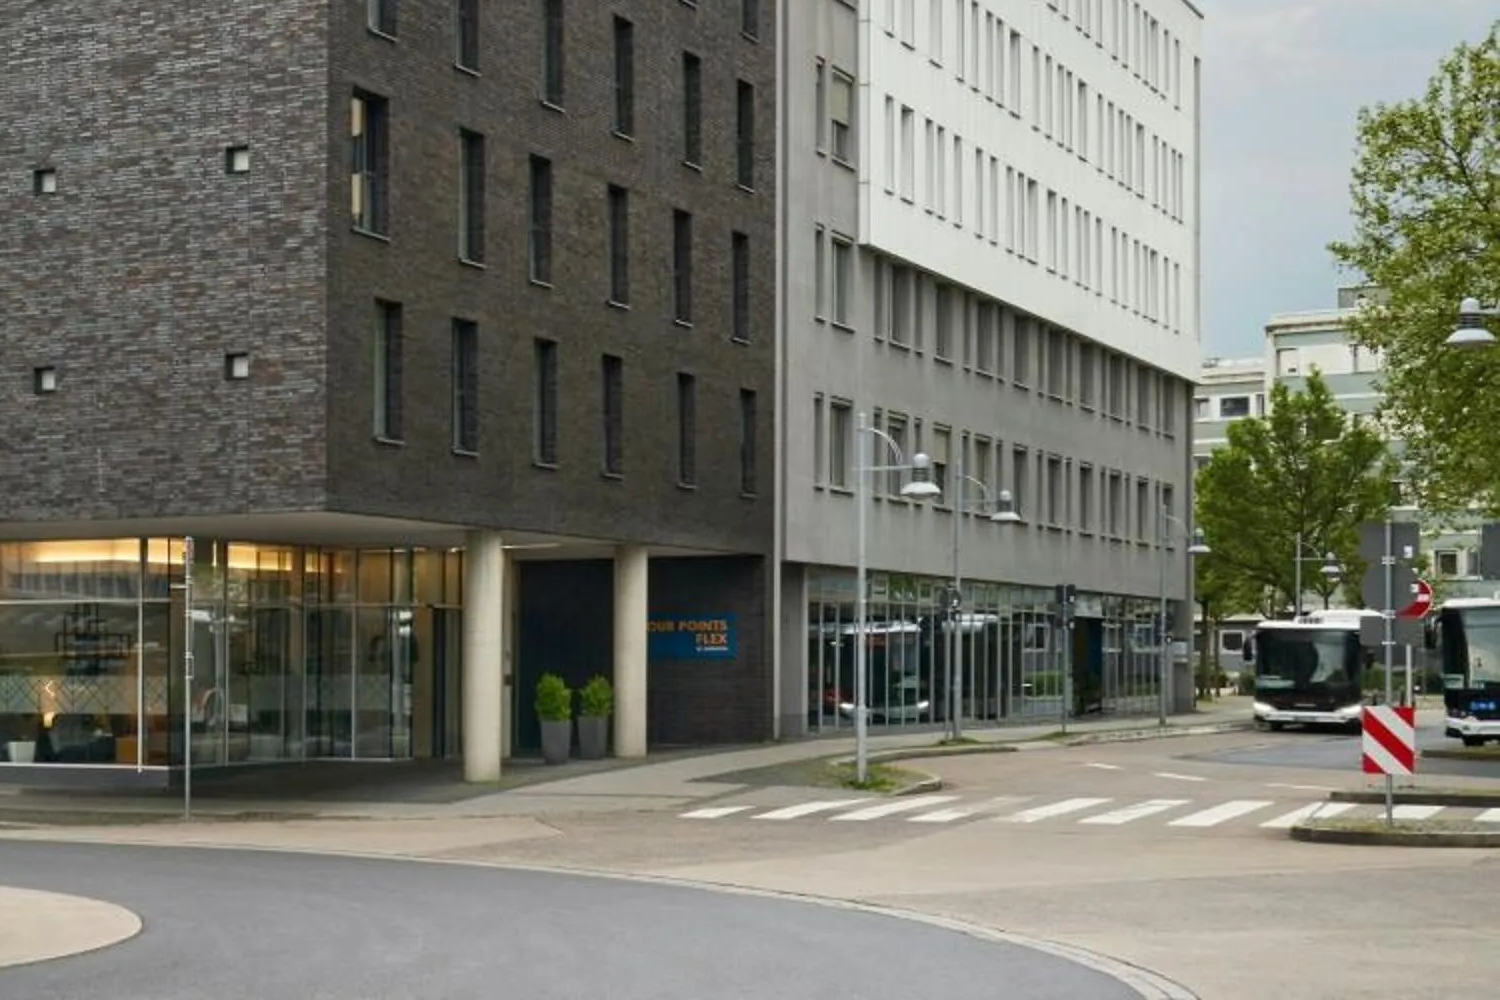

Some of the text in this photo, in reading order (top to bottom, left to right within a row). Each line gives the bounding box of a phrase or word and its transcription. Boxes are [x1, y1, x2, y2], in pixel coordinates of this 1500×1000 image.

[647, 619, 728, 632] OUR POINTS
[695, 632, 727, 645] FLEX
